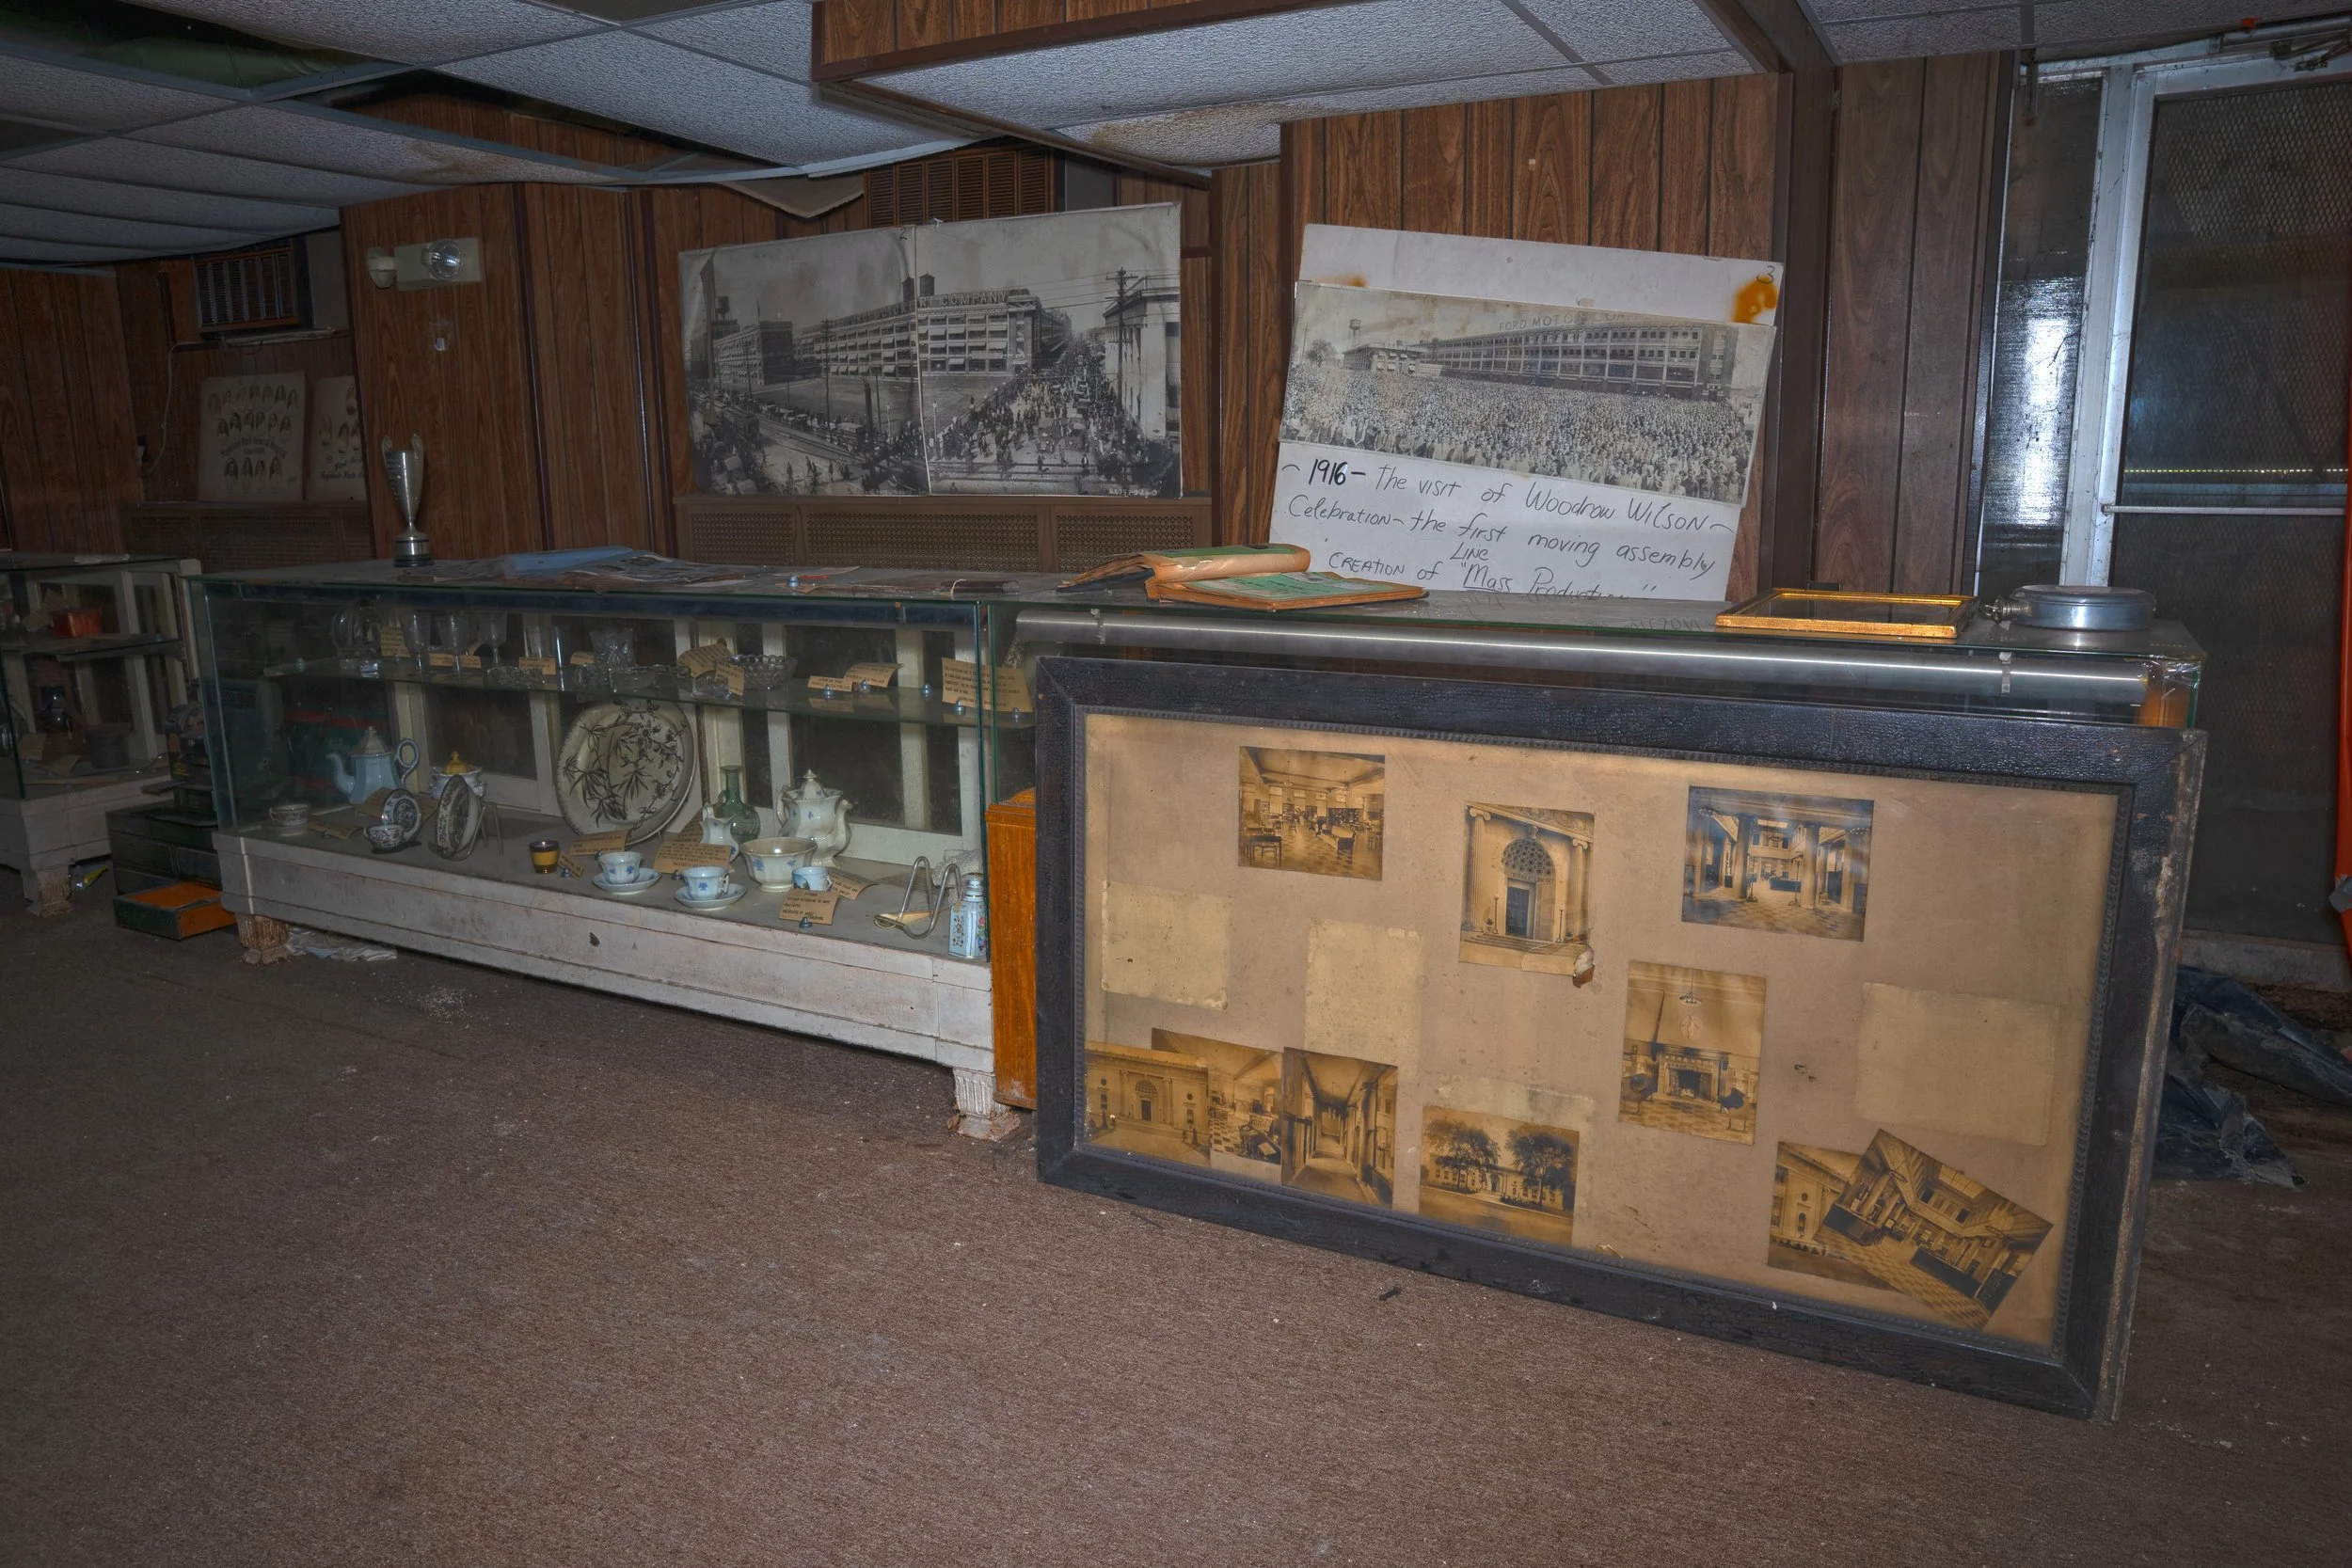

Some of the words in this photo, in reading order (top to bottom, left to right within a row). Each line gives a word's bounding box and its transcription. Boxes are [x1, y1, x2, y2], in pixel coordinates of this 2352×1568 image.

[1756, 264, 1775, 284] 3
[941, 291, 1006, 307] COMPANY
[1499, 319, 1527, 331] FORD
[1481, 483, 1513, 502] of
[1525, 482, 1616, 520] Woodrow
[1527, 533, 1602, 568] moving
[1616, 544, 1716, 581] assembly
[1417, 562, 1444, 580] of
